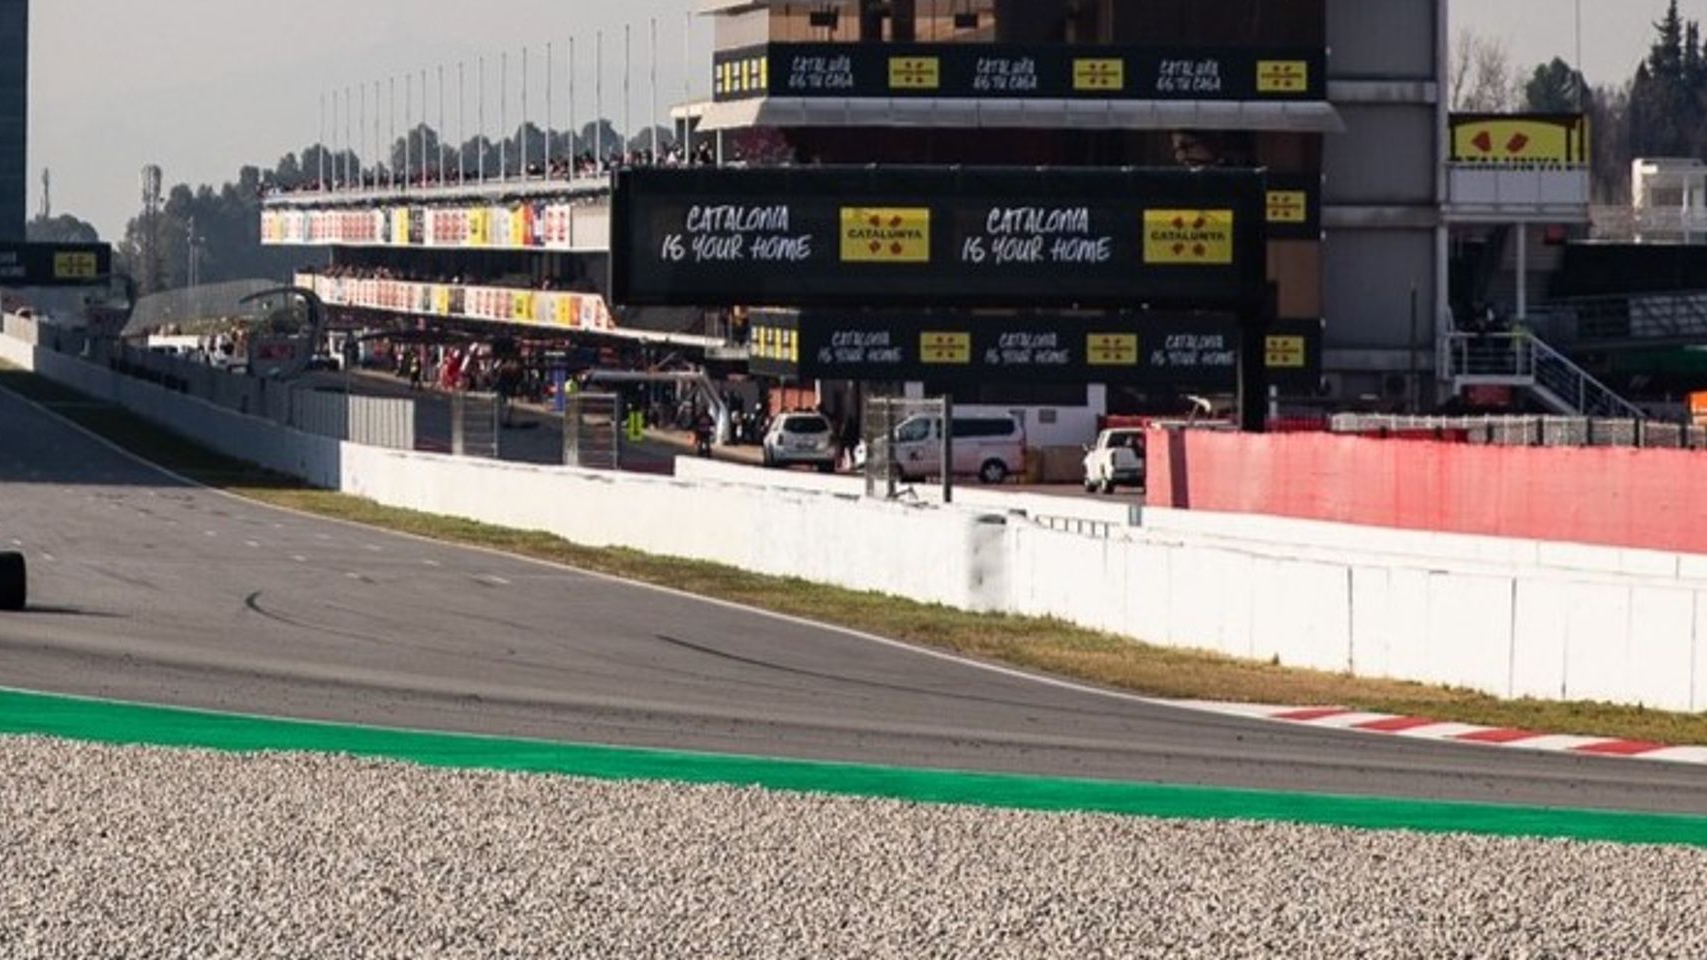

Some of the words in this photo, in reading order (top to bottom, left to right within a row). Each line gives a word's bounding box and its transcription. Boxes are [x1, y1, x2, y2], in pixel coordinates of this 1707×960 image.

[687, 205, 788, 232] CATALONIA
[987, 208, 1088, 233] CATALONIA
[662, 234, 685, 260] IS
[692, 234, 743, 261] YOUR
[750, 235, 812, 260] HOME
[848, 227, 922, 241] CATALUNYA
[962, 237, 985, 262] IS
[992, 235, 1043, 263] YOUR
[1050, 237, 1111, 262] HOME
